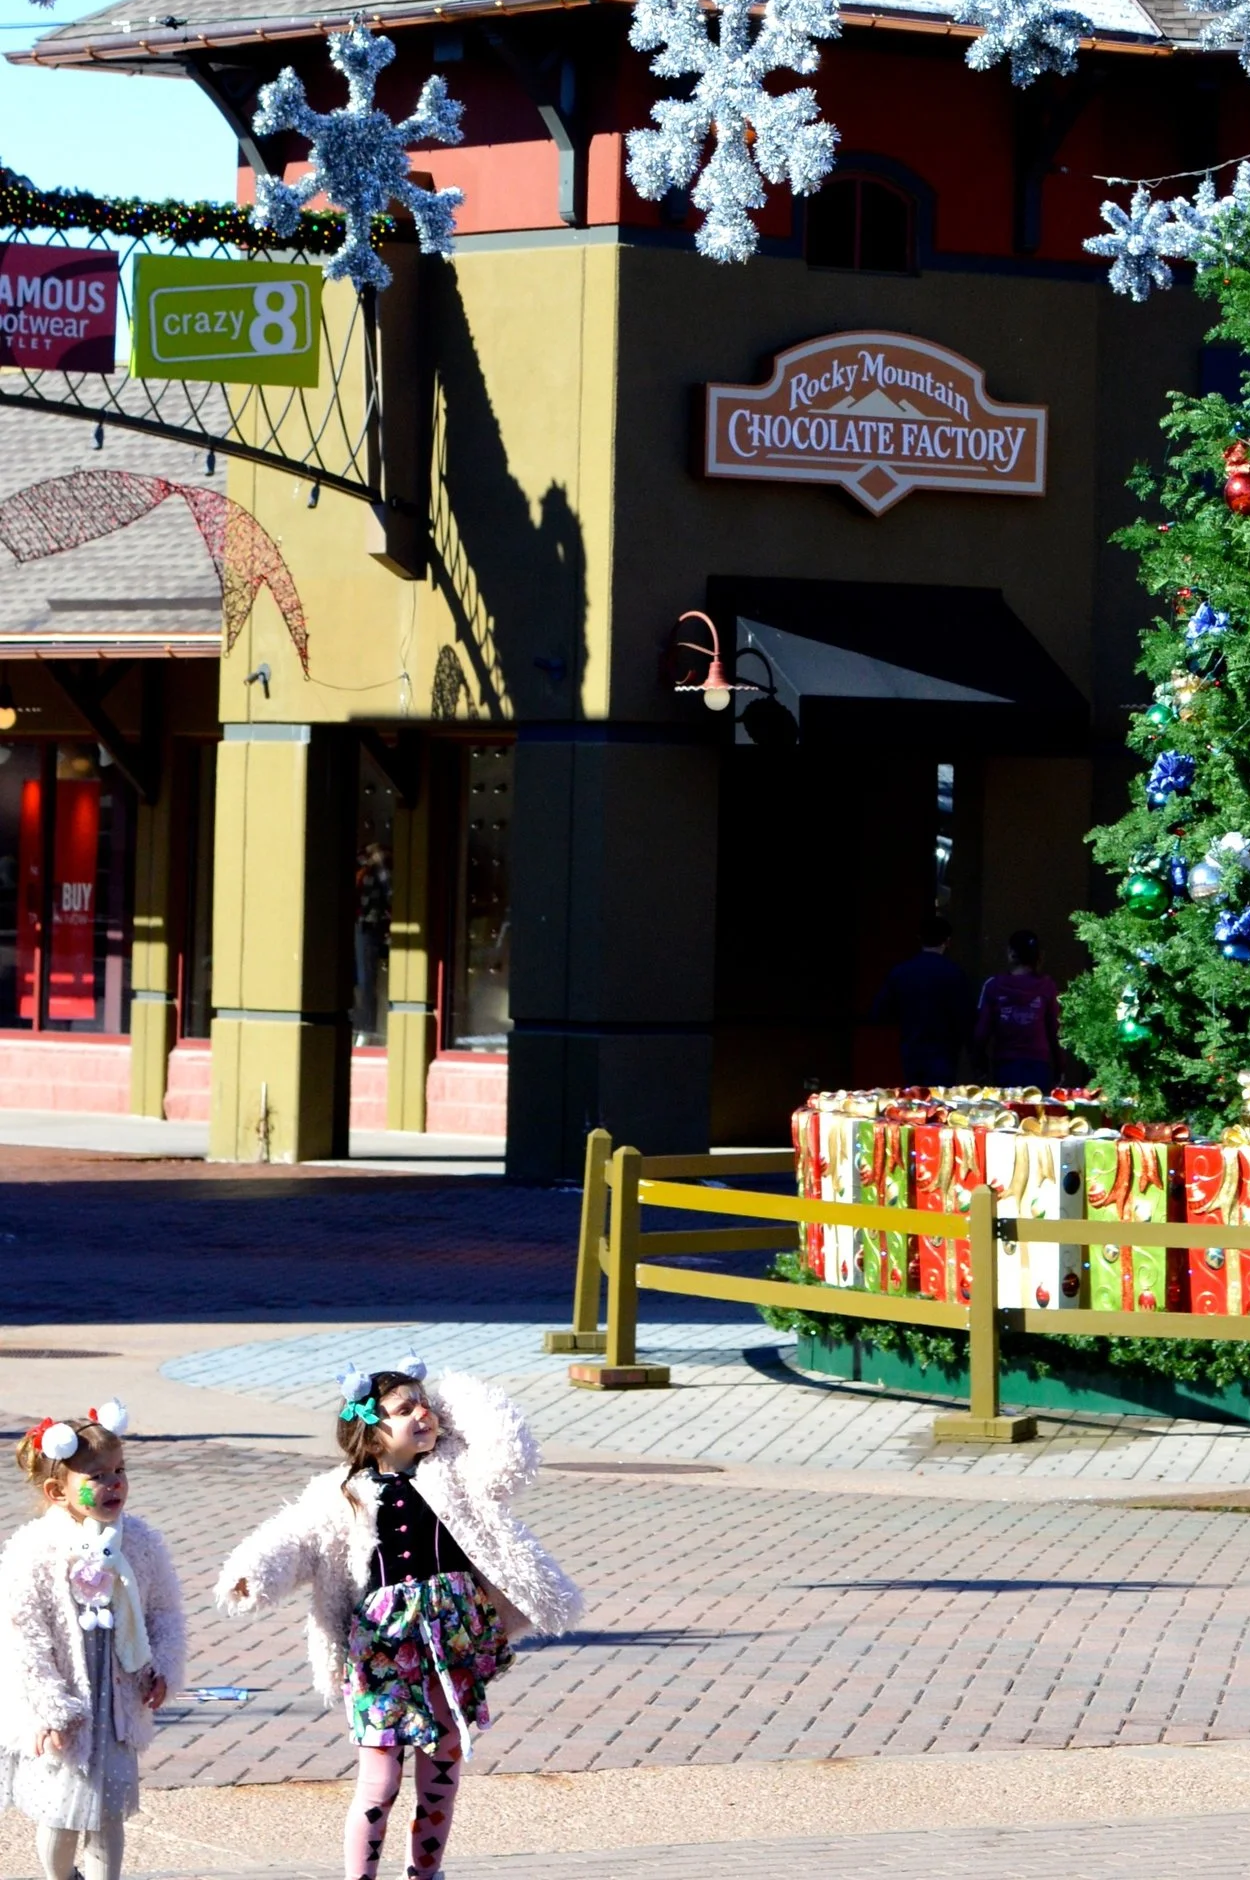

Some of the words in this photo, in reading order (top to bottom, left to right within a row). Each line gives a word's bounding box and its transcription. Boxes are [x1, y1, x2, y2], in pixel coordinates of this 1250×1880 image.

[0, 310, 90, 339] otwear
[163, 310, 244, 340] crazy
[249, 282, 298, 354] 8
[788, 359, 859, 411] Rocky
[858, 350, 970, 422] Mountain
[728, 408, 895, 458] CHOCOLATE
[901, 423, 1027, 473] FACTORY
[62, 881, 93, 912] BUY
